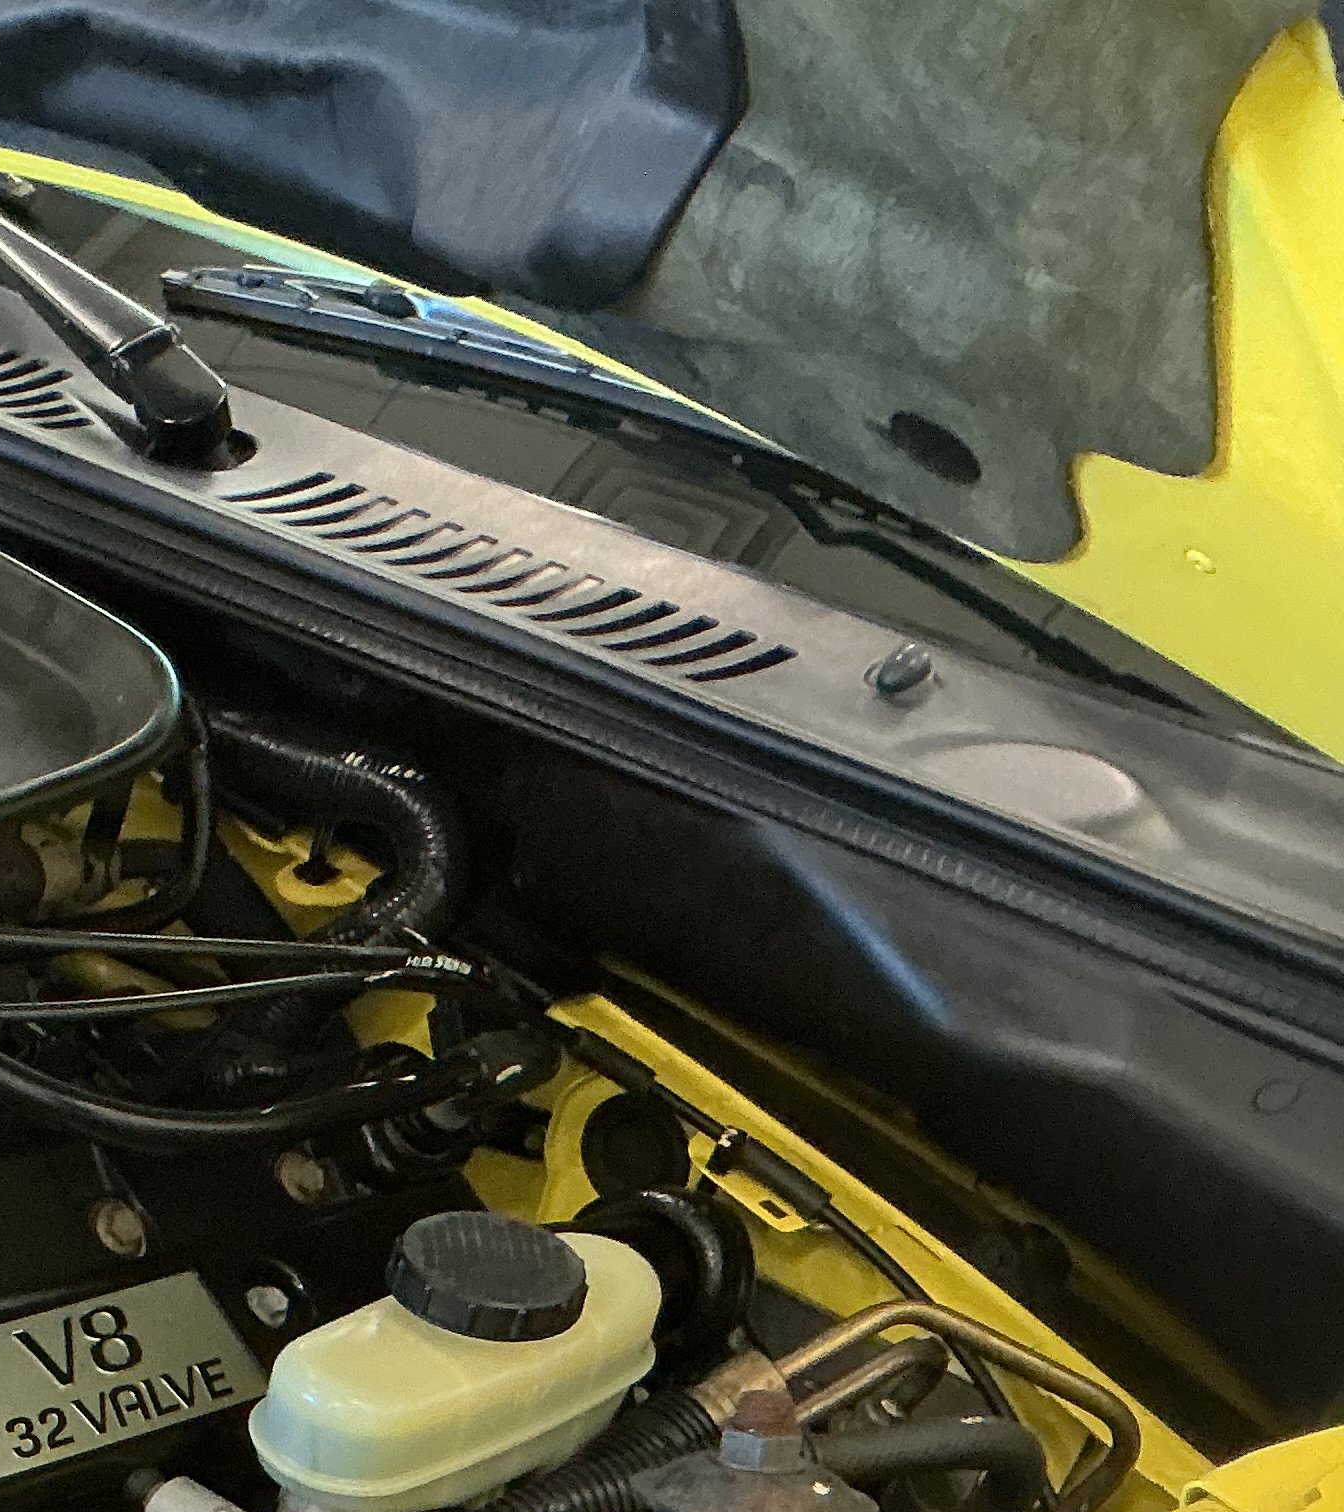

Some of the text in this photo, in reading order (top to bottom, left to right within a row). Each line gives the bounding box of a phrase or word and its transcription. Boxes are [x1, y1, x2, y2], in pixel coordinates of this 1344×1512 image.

[13, 1304, 143, 1388] V8
[5, 1357, 234, 1459] 32 VALVE
